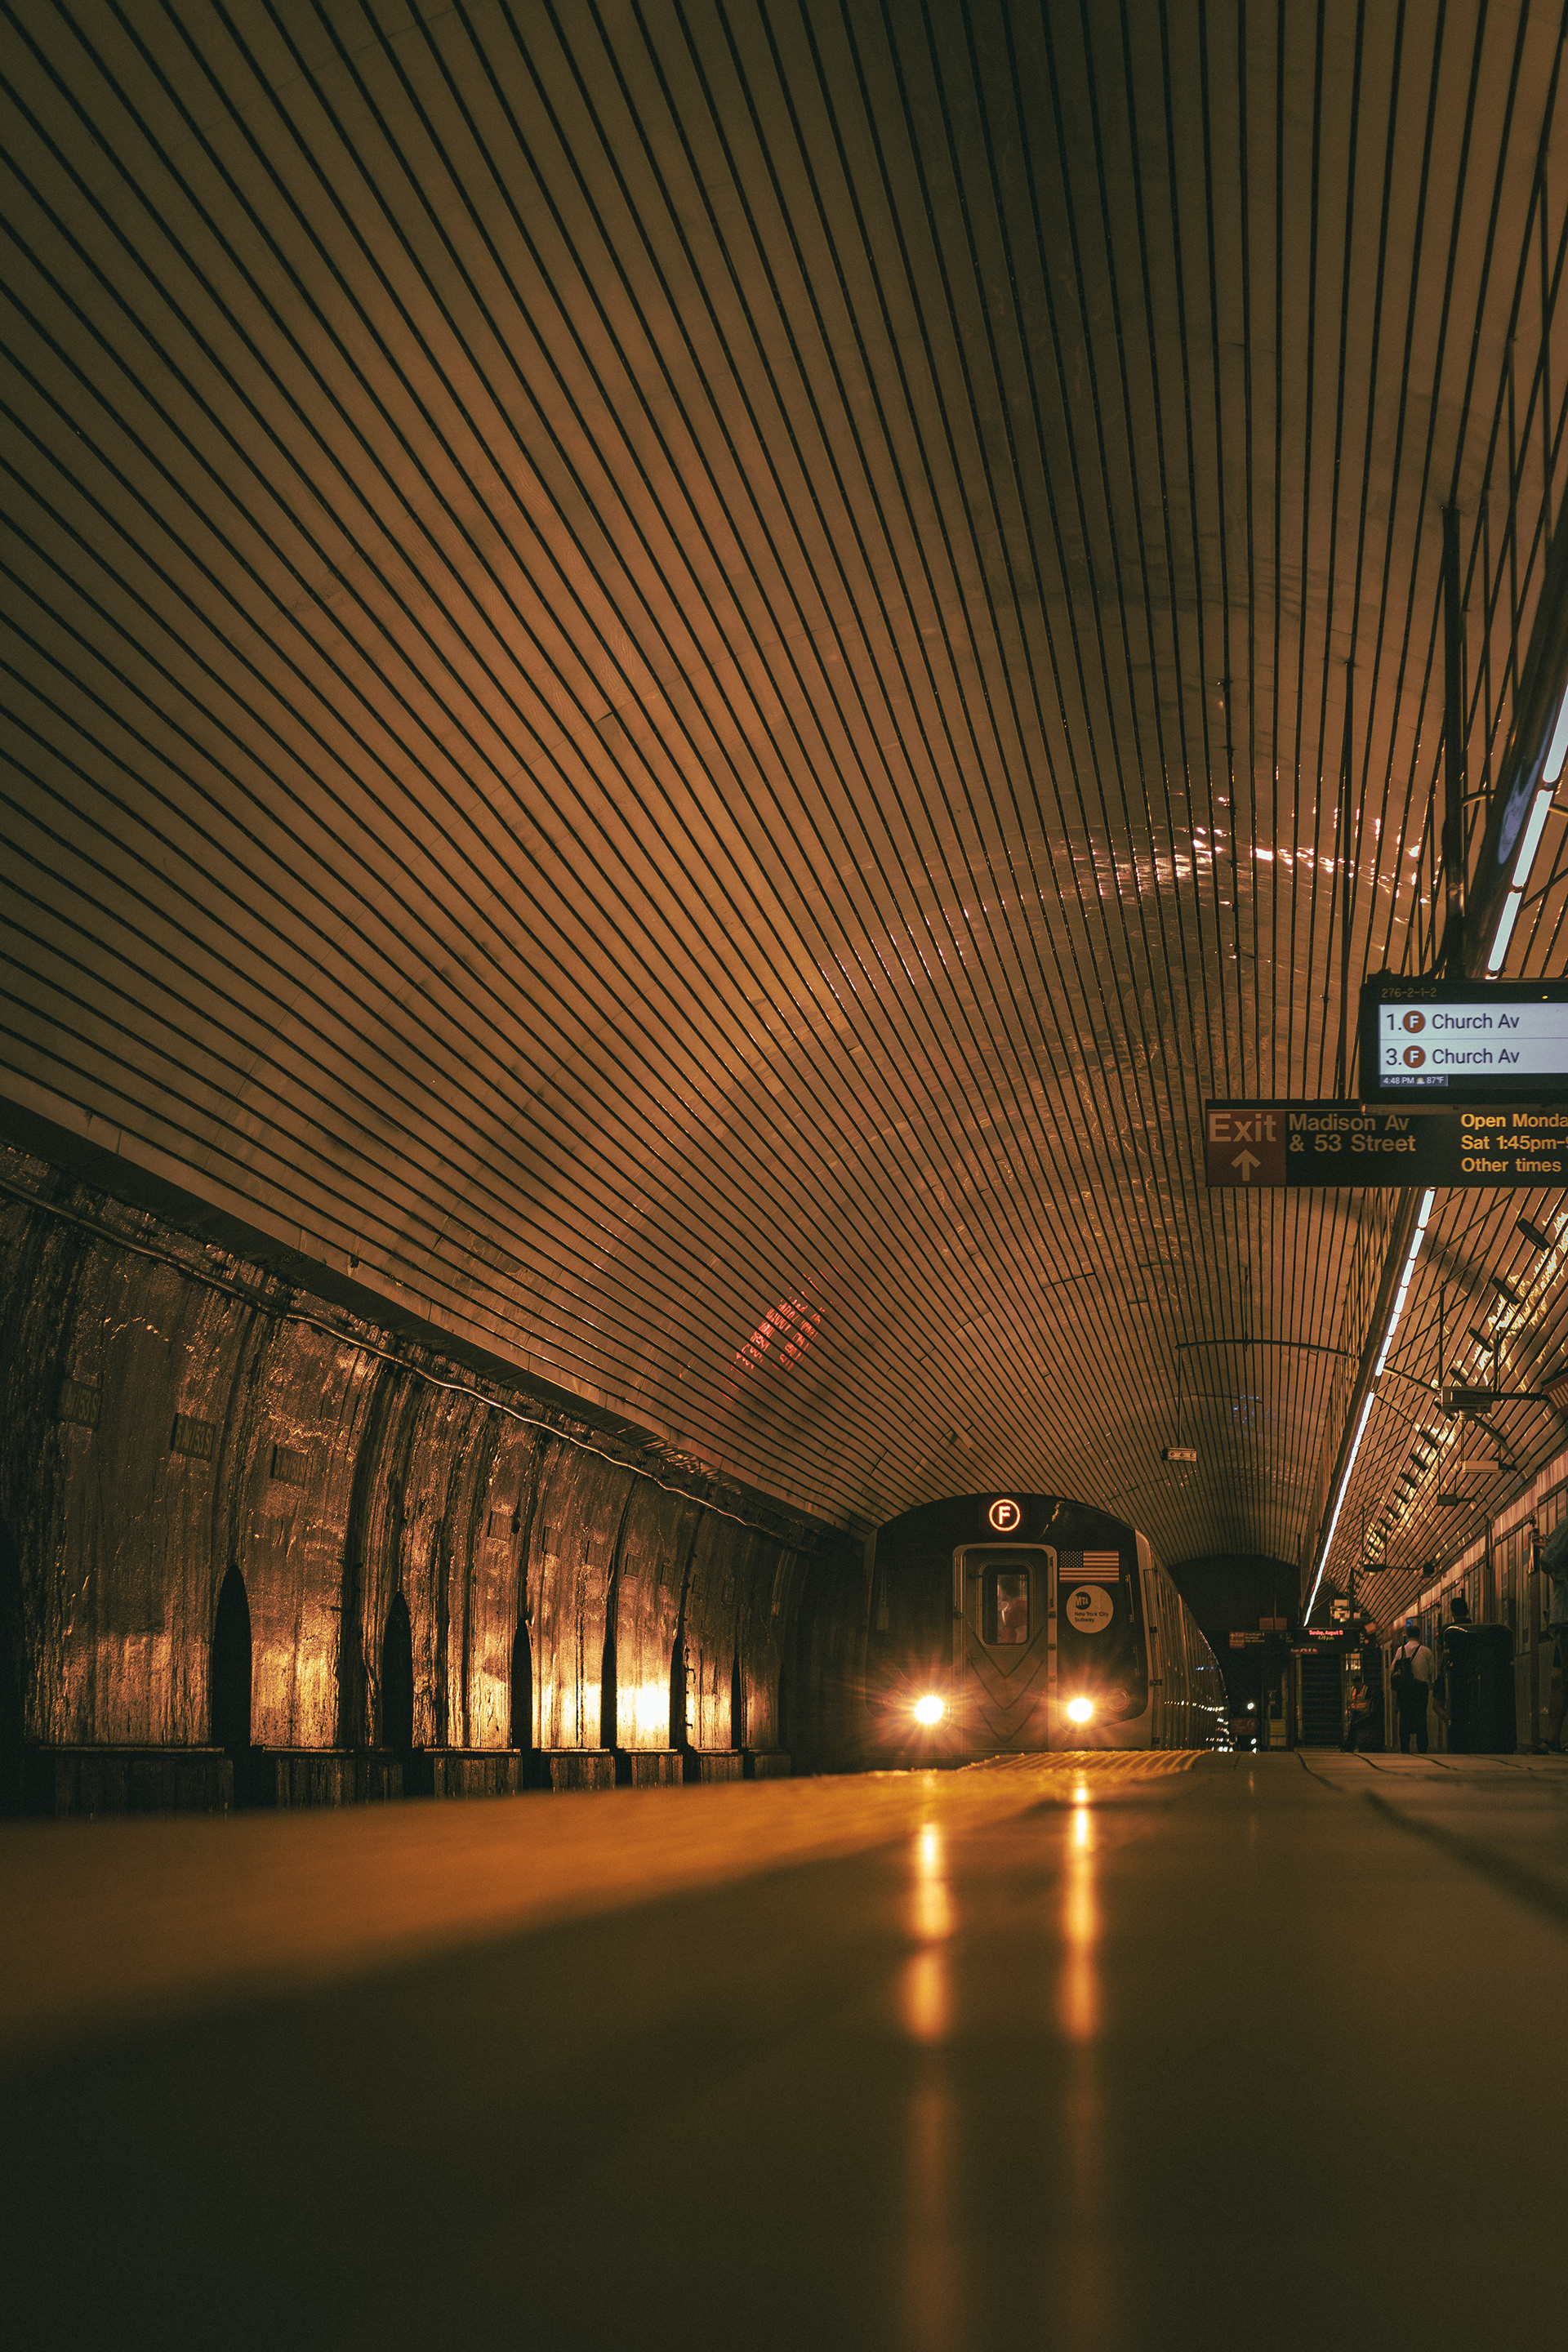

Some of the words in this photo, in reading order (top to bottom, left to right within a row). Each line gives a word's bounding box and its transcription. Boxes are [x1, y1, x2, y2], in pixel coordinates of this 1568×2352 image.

[1381, 987, 1437, 998] 276-2-1-2
[1386, 1013, 1401, 1031] 1.
[1432, 1013, 1493, 1029] Church
[1498, 1013, 1520, 1029] Av
[1386, 1048, 1402, 1066] 3.
[1432, 1048, 1493, 1064] Church
[1498, 1048, 1520, 1064] Av
[1383, 1076, 1401, 1085] 4:48
[1401, 1076, 1414, 1085] PM
[1209, 1112, 1276, 1143] Exit
[1289, 1113, 1376, 1131] Madison
[1384, 1114, 1410, 1131] Av
[1460, 1113, 1507, 1130] Open
[1512, 1112, 1568, 1128] Monda
[1289, 1134, 1305, 1152] &
[1313, 1134, 1342, 1152] 53
[1350, 1134, 1416, 1152] Street
[1461, 1134, 1490, 1150] Sat
[1461, 1157, 1509, 1173] Other
[1515, 1157, 1562, 1173] times
[999, 1505, 1011, 1525] F
[1075, 1595, 1089, 1606] MTA
